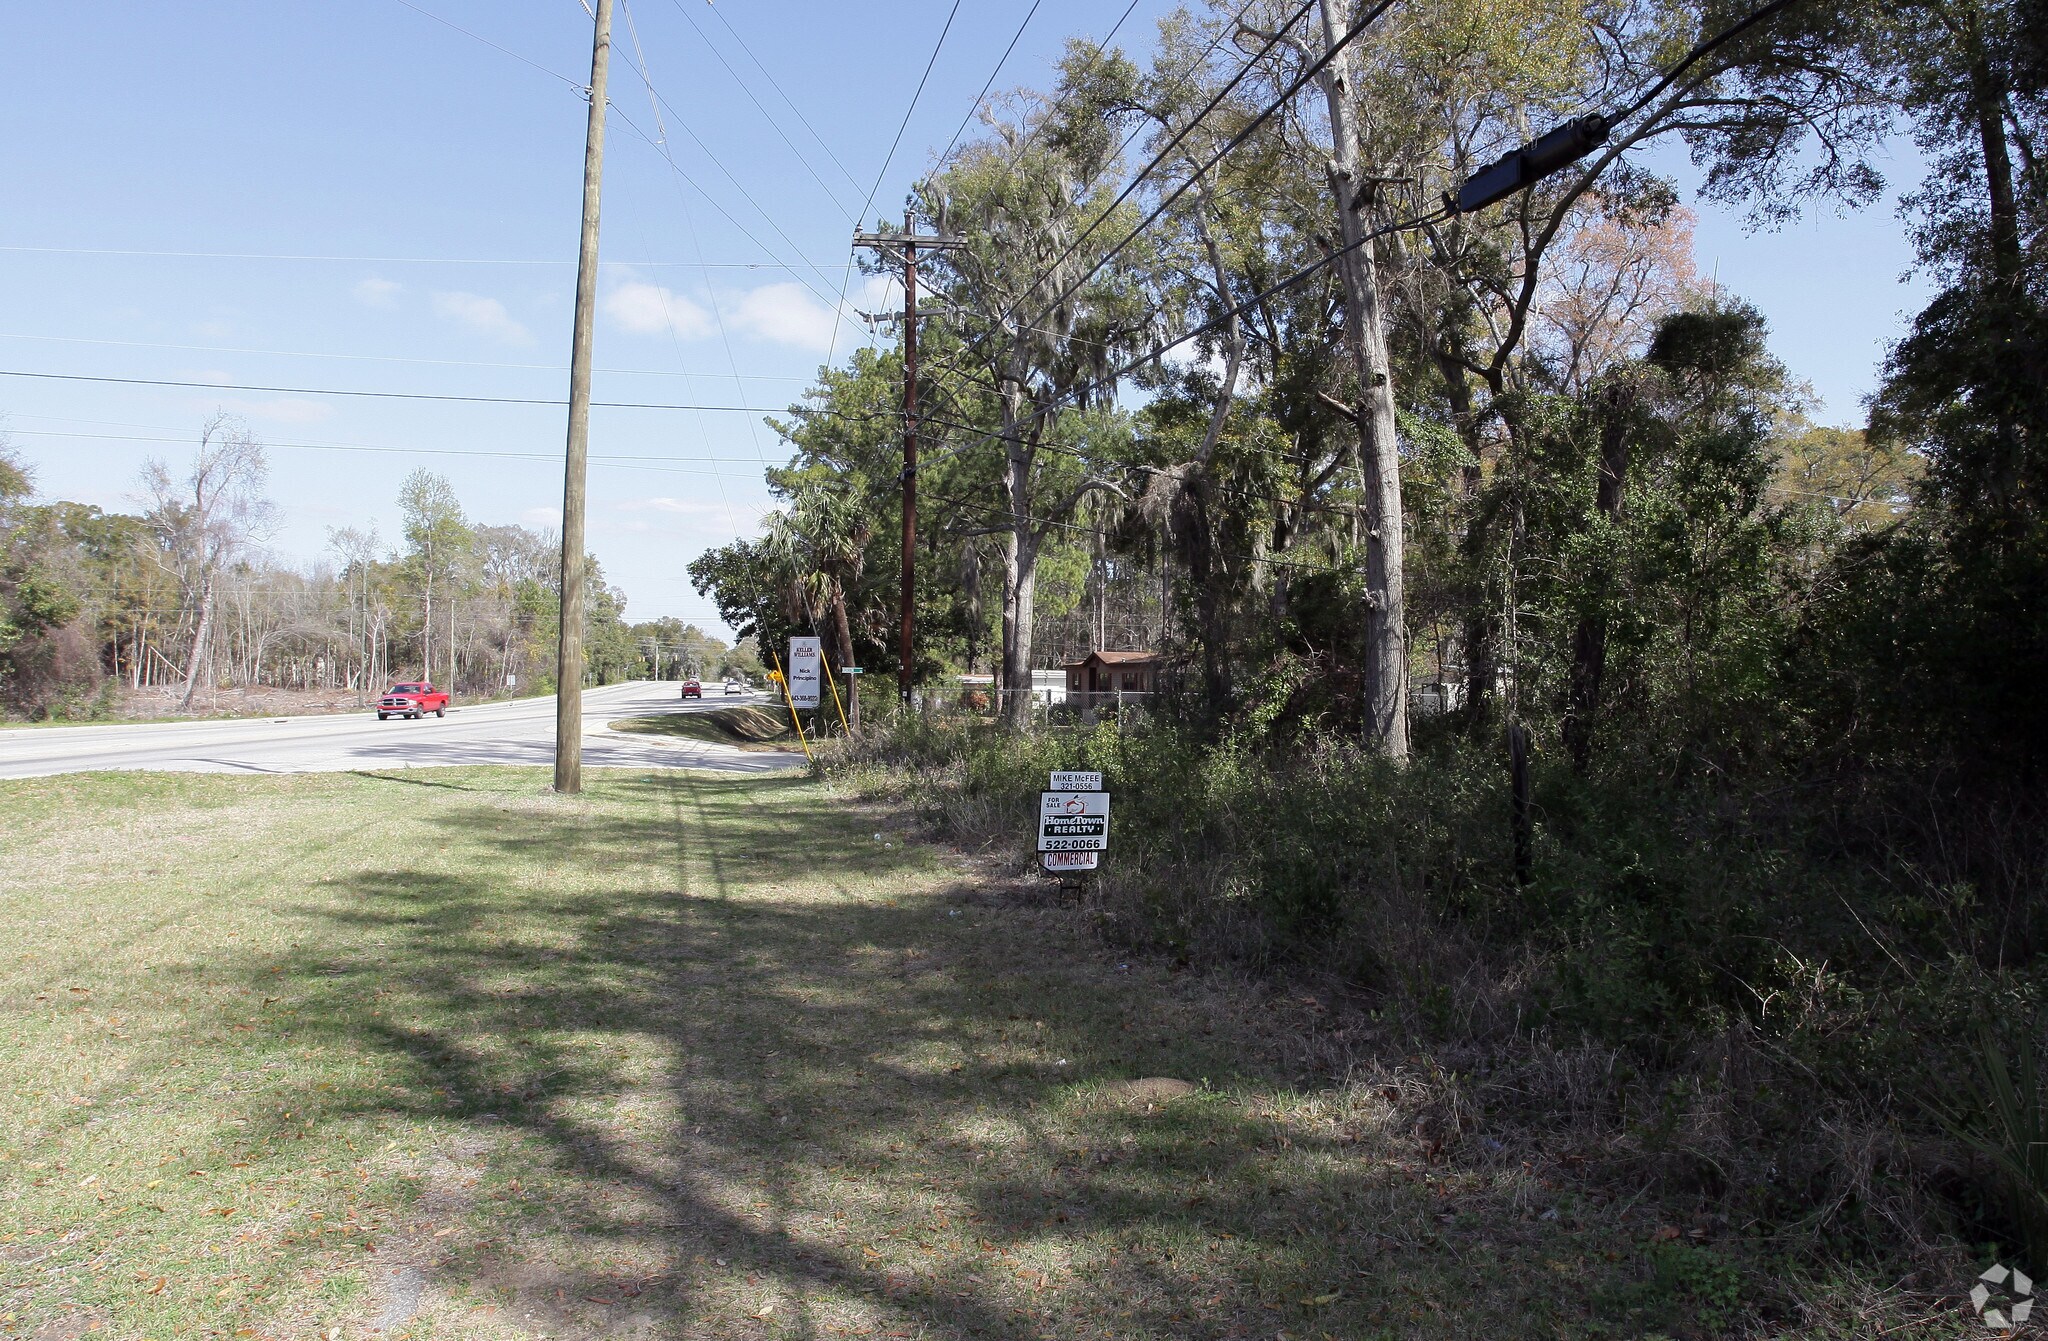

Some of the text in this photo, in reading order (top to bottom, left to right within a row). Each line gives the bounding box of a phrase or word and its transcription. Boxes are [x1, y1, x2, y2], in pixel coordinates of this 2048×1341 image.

[1044, 816, 1104, 825] HomeTown
[1054, 825, 1094, 833] REALTY
[1047, 853, 1094, 866] COMMERCIAL
